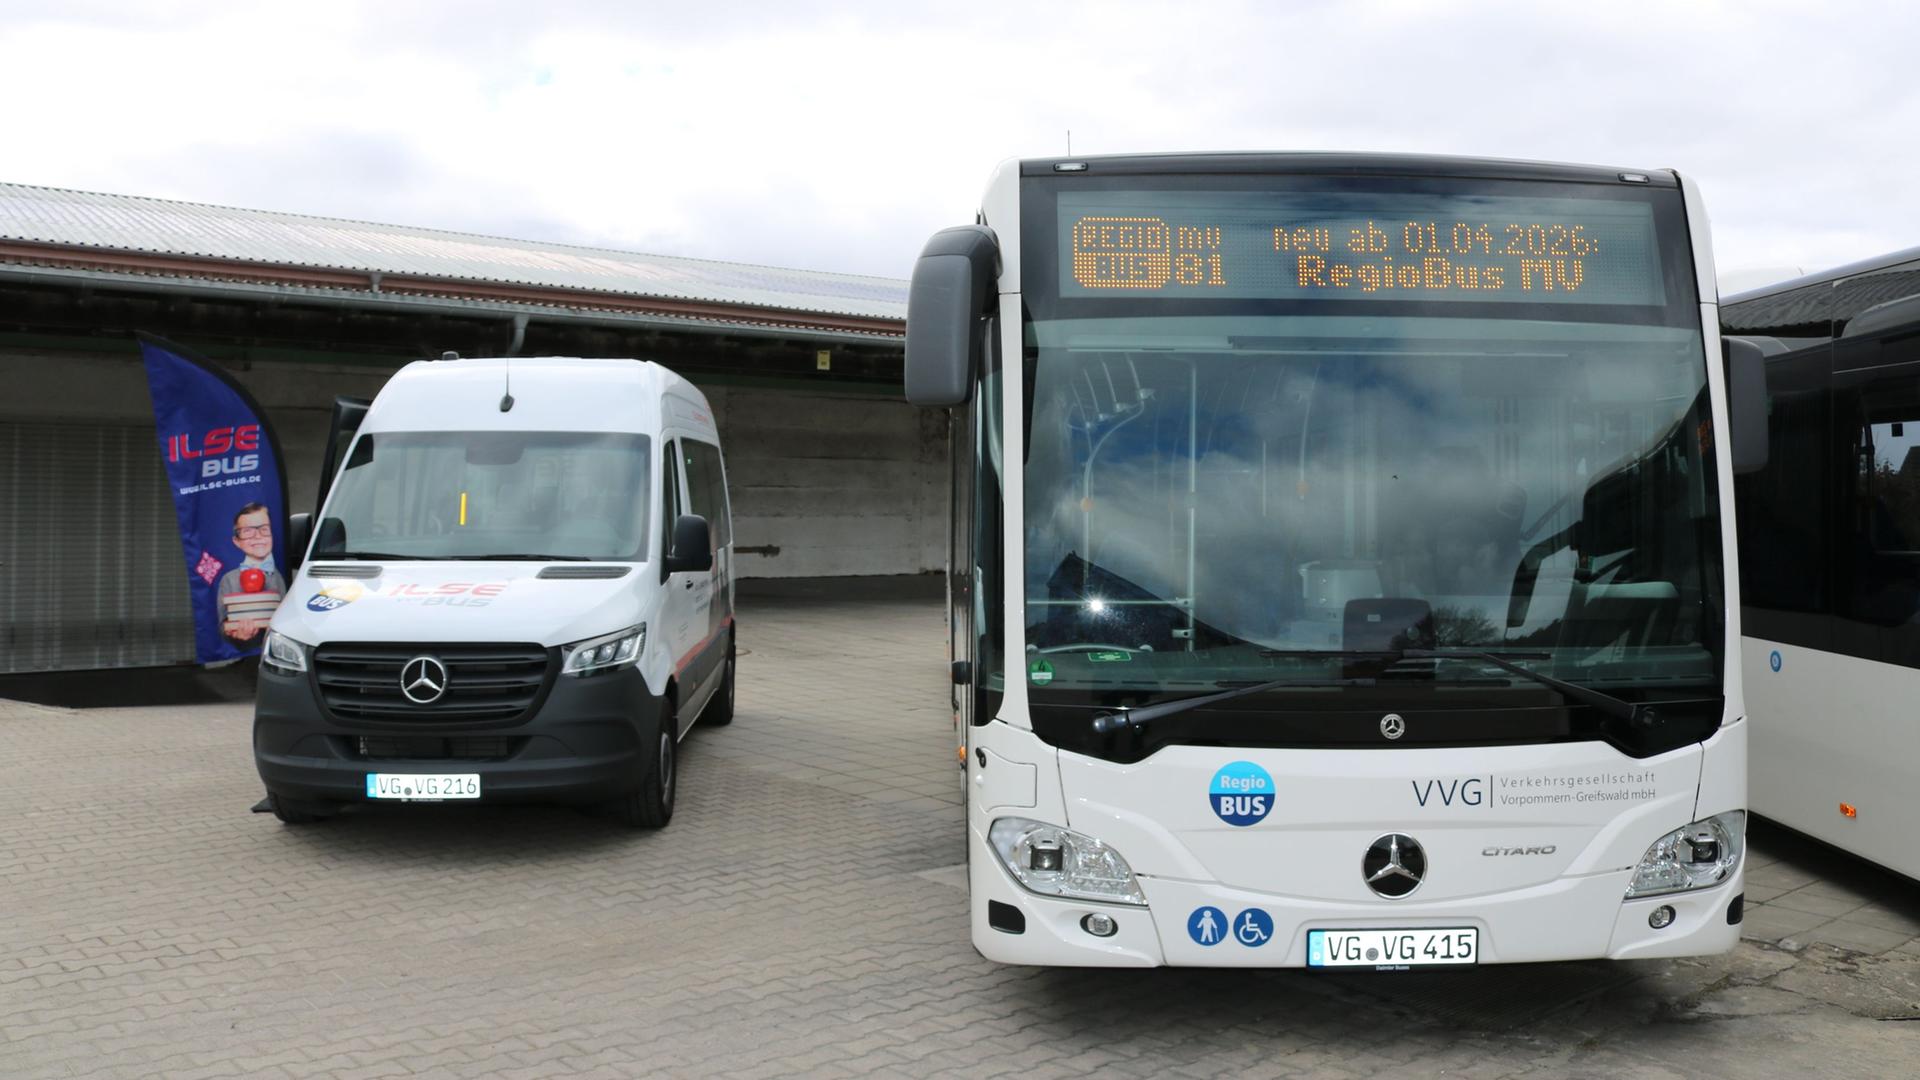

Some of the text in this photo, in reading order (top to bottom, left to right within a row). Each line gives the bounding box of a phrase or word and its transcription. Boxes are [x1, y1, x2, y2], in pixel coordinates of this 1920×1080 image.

[1082, 225, 1161, 249] REGIO
[1273, 220, 1600, 256] neu ab 01.04.2026:
[1095, 256, 1150, 280] BUS
[1175, 253, 1227, 285] 81
[1297, 254, 1585, 292] RegioBus MV
[168, 424, 260, 463] ILSE
[201, 454, 259, 478] BUS
[388, 582, 508, 597] ILSE
[309, 595, 344, 609] BUS
[421, 597, 494, 607] BUS
[378, 777, 477, 795] VG VG 216
[1220, 774, 1266, 792] Regio
[1499, 772, 1656, 788] Verkehrsgesellschaft
[1412, 778, 1483, 807] VVG
[1499, 788, 1656, 807] Vorpommern-Greifswald mbH
[1220, 796, 1266, 816] BUS
[1481, 844, 1557, 857] CITARO
[1328, 934, 1472, 961] VG VG 415
